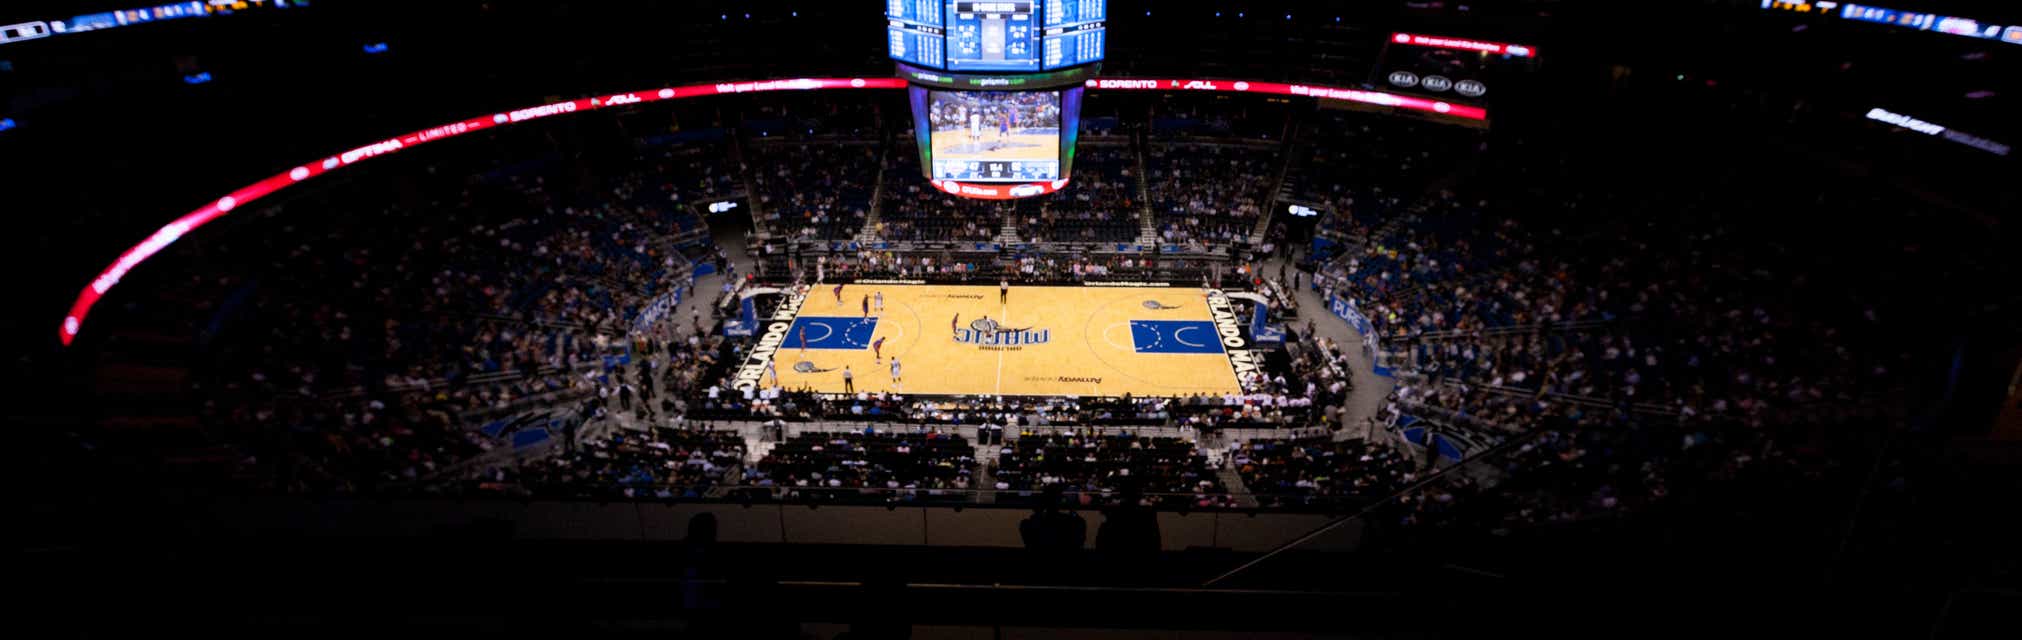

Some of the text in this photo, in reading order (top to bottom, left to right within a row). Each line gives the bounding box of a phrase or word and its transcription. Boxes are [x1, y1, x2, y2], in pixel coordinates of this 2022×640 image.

[1099, 79, 1157, 89] SORENTO
[510, 101, 577, 122] SORENTO
[418, 122, 467, 142] LIMITED
[341, 139, 403, 164] OPTIMA
[1332, 299, 1362, 331] PURE
[1058, 376, 1102, 385] Amway
